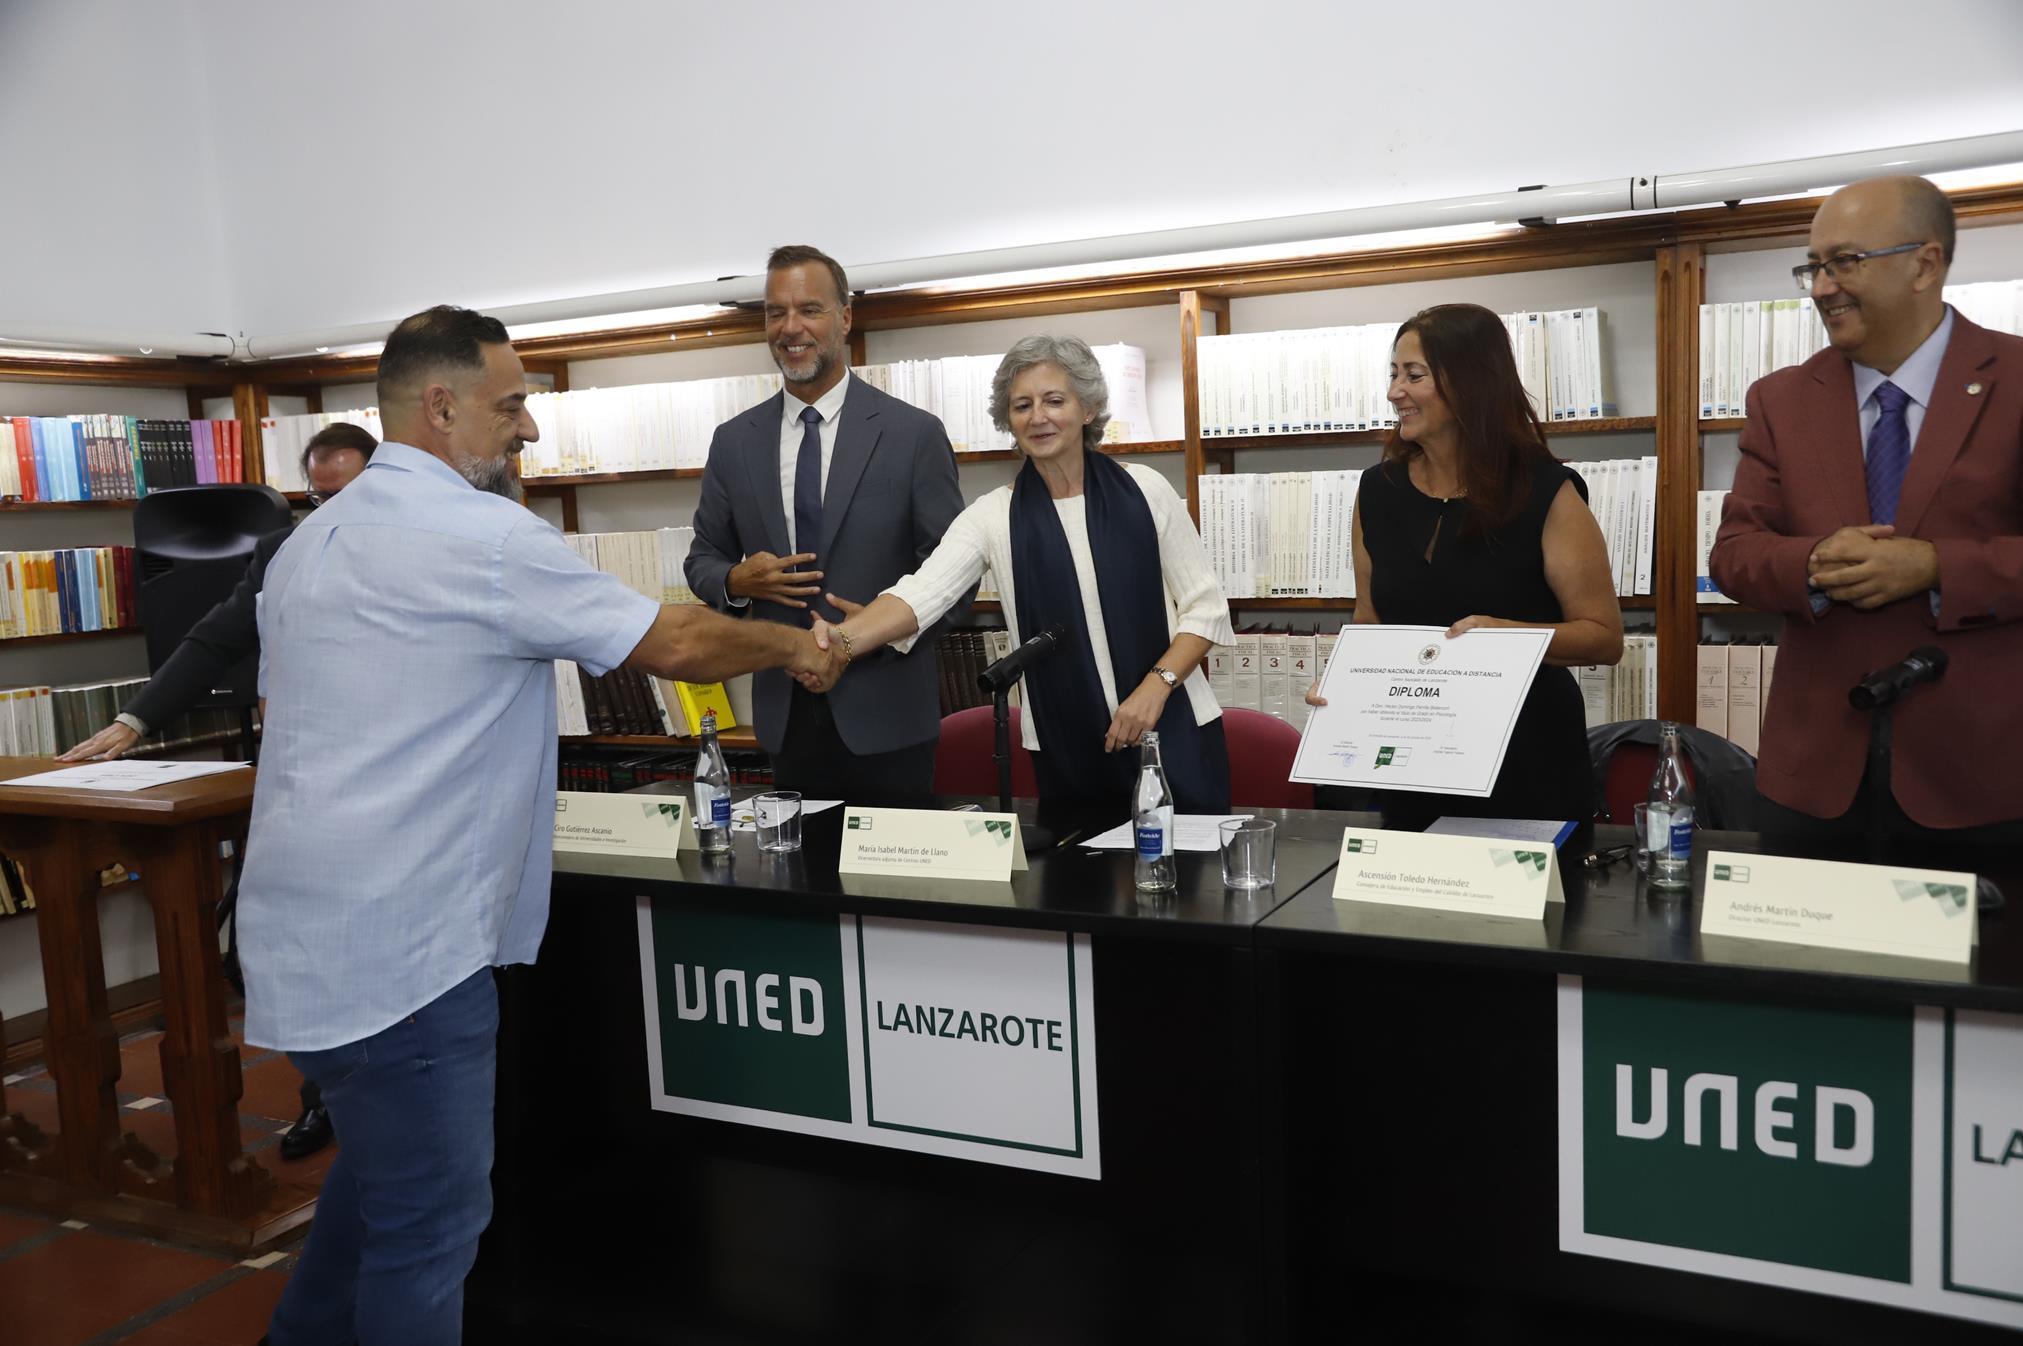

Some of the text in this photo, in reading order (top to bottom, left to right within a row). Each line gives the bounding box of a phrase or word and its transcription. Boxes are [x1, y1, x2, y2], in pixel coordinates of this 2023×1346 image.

[1215, 658, 1220, 668] 1
[1242, 658, 1250, 667] 2
[1270, 658, 1279, 667] 3
[1296, 660, 1304, 670] 4
[1742, 676, 1747, 685] 2
[1389, 686, 1440, 697] DIPLOMA
[592, 827, 612, 835] Ascanio
[878, 846, 896, 854] Isabel
[931, 848, 948, 856] Llano
[1358, 870, 1470, 888] Ascensión Toledo Hernández
[1730, 901, 1763, 912] Andrés
[1801, 908, 1833, 922] Duque
[674, 963, 825, 1036] UNED
[877, 1000, 1063, 1052] LANZAROTE
[1616, 1063, 1874, 1167] UNED
